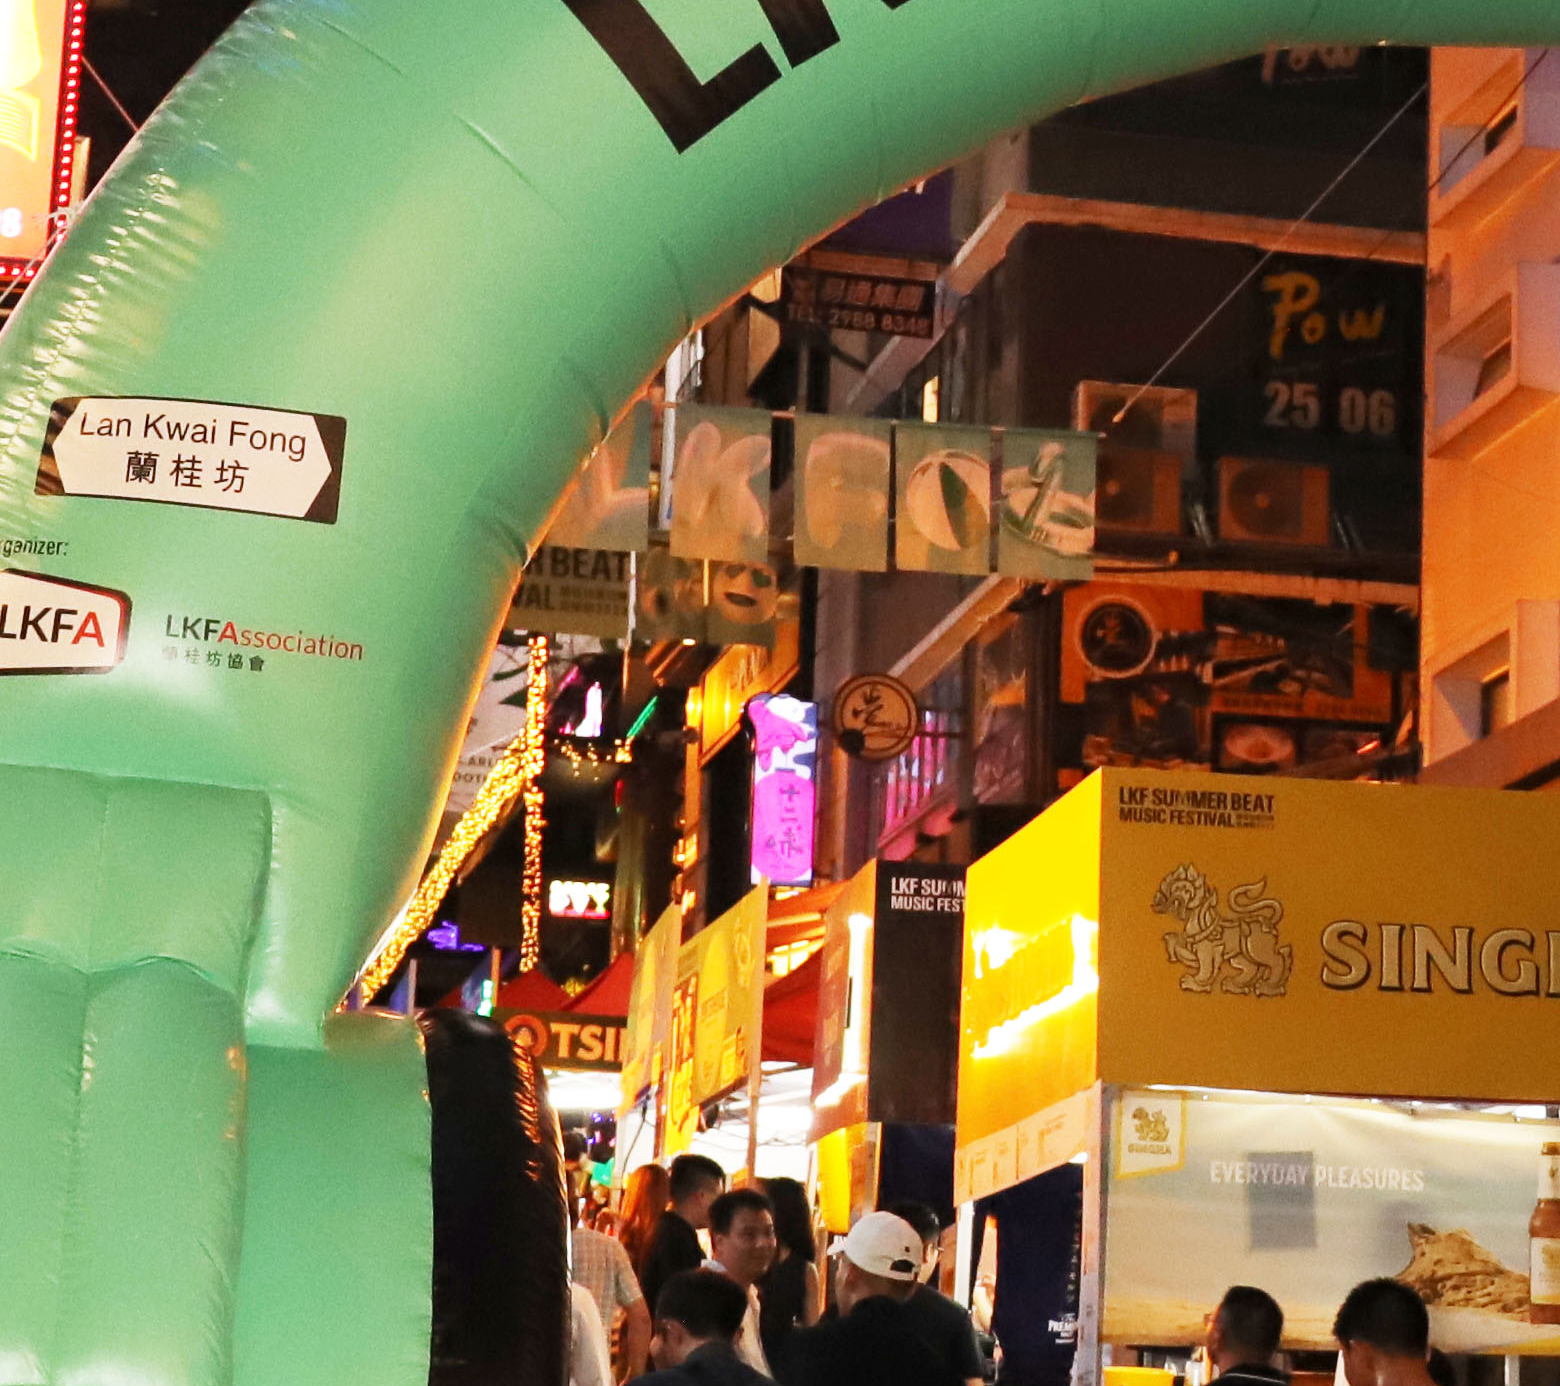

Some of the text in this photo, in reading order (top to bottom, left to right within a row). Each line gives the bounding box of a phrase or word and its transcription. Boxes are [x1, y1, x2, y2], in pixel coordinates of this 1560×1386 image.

[1262, 271, 1386, 361] Pow
[1263, 381, 1397, 437] 25 06
[79, 411, 307, 462] Lan Kwai Fong
[125, 449, 250, 493] 蘭桂坊
[551, 546, 627, 581] BEAT
[164, 613, 364, 661] LKFAssociation
[162, 645, 264, 672] 蘭桂坊協會
[1118, 786, 1275, 813] LKF SUMMER BEAT
[1118, 807, 1168, 824] MUSIC
[1169, 809, 1235, 828] FESTIVAL
[891, 877, 920, 895] LKF
[891, 895, 935, 912] MUSIC
[1209, 1160, 1425, 1192] EVERYDAY PLEASURES
